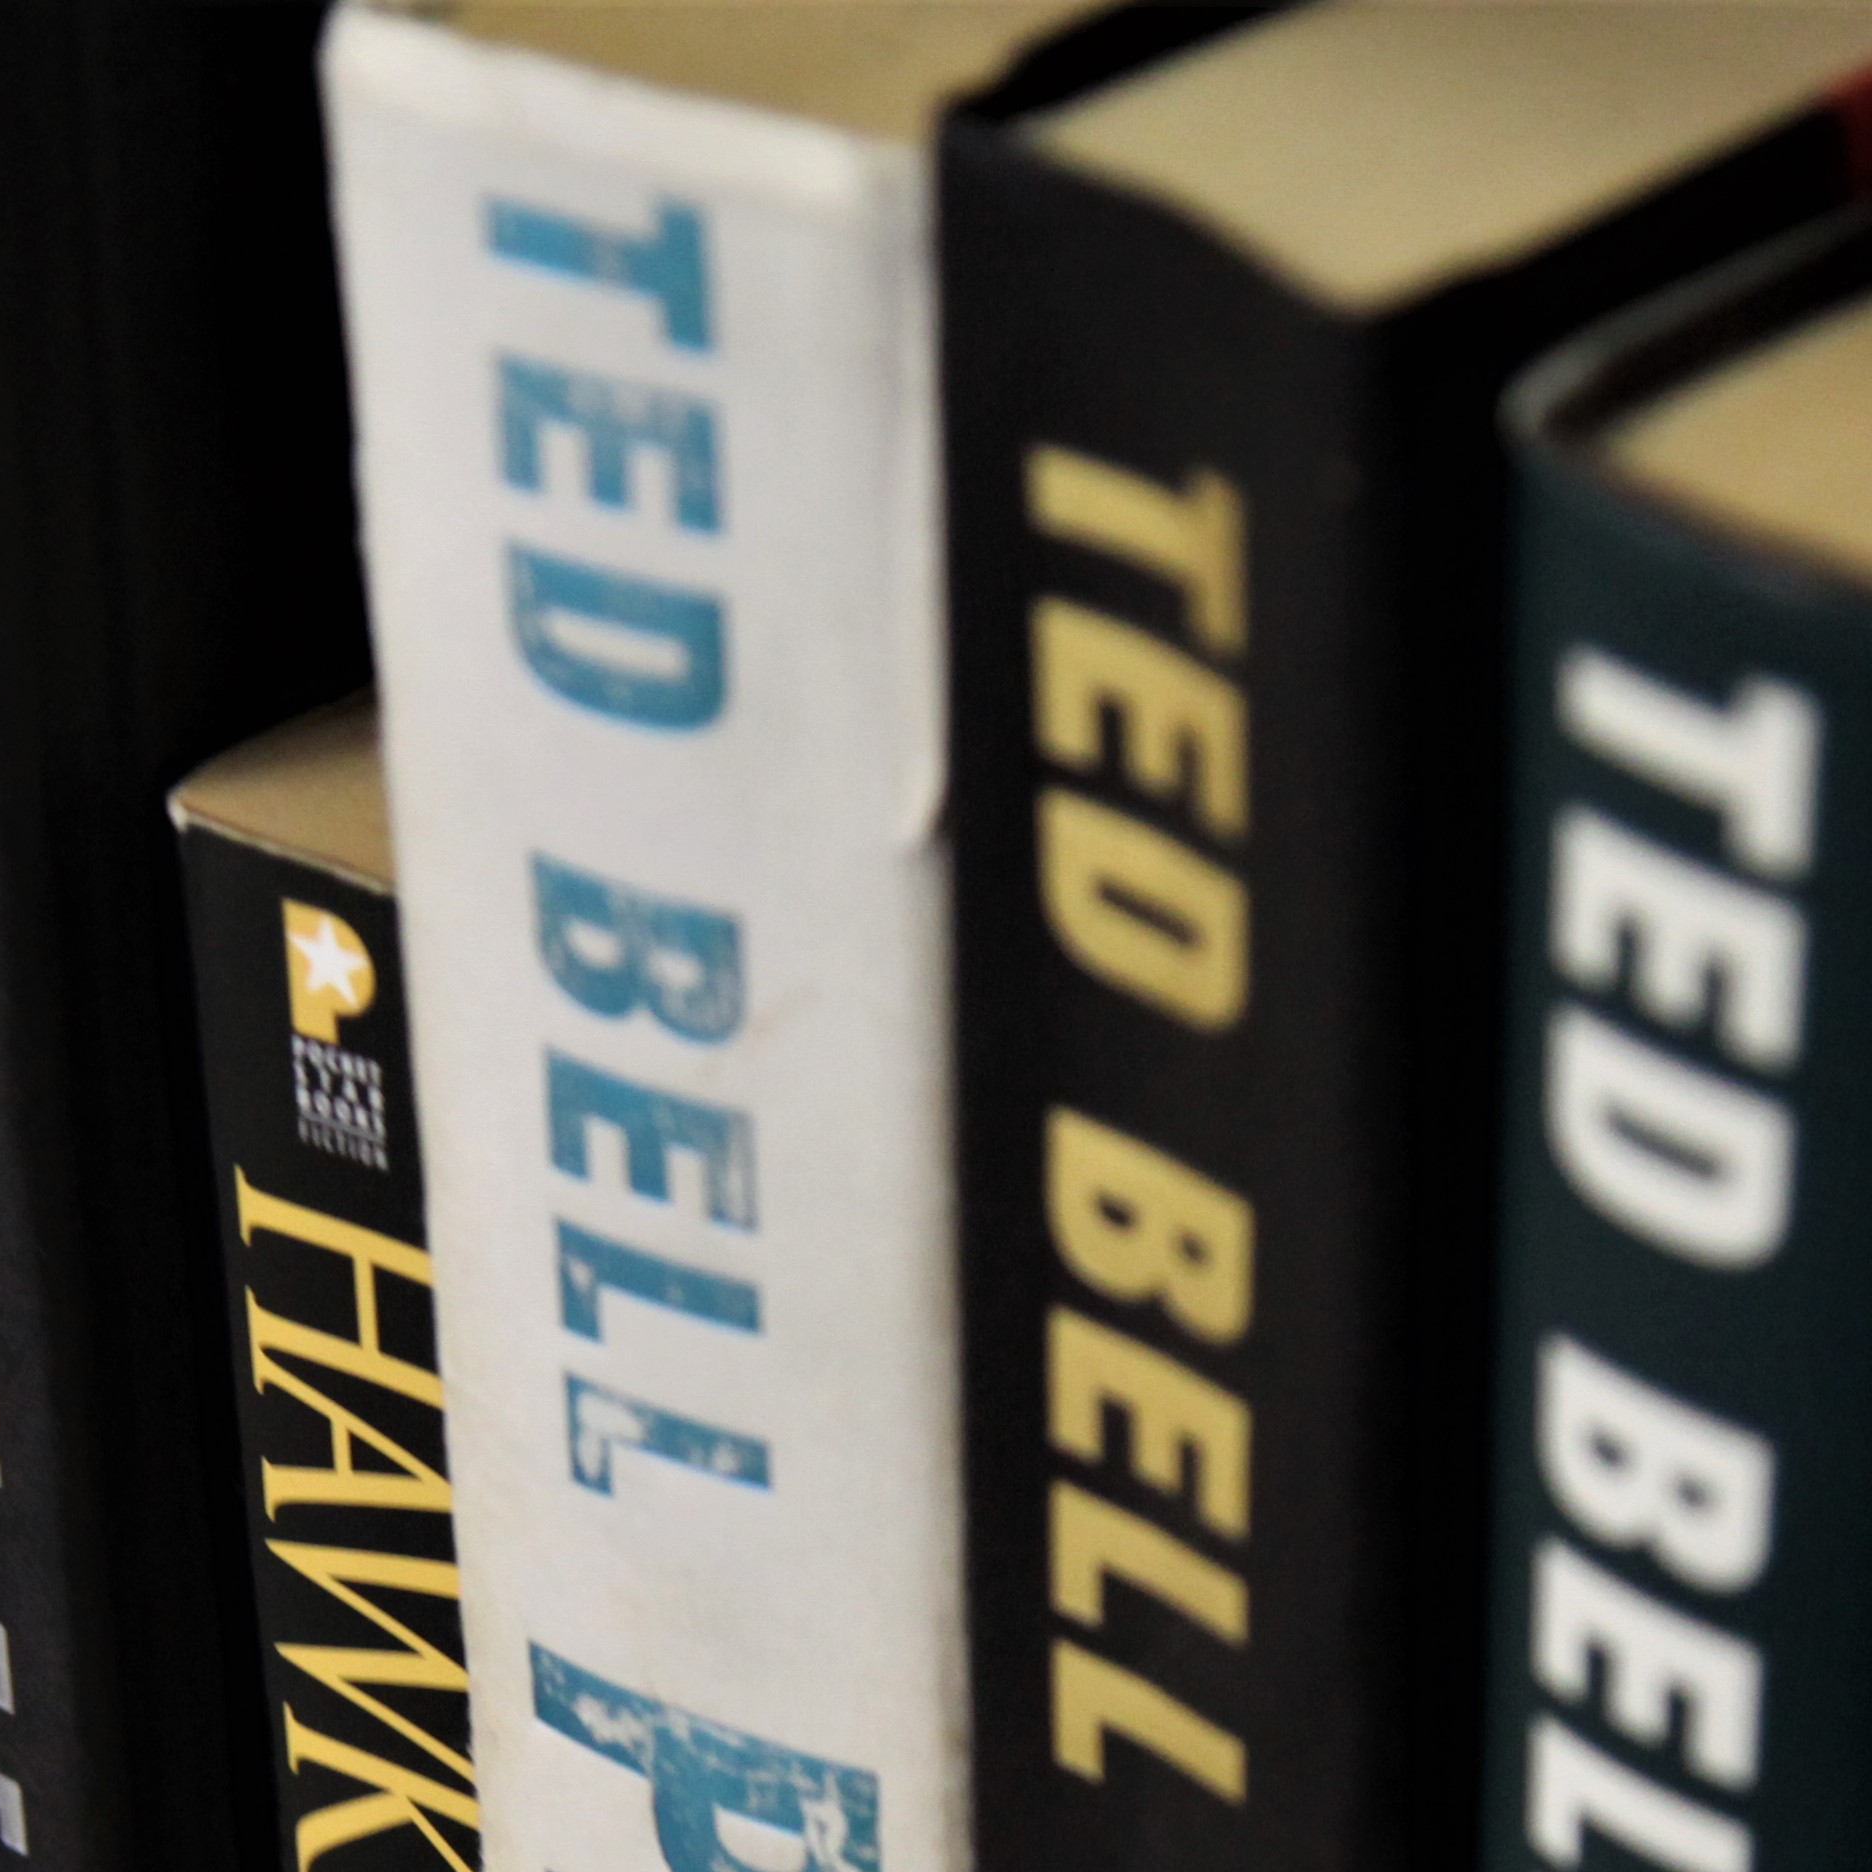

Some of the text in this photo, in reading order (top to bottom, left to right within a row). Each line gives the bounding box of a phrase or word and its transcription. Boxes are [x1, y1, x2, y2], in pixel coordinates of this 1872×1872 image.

[478, 196, 774, 1497] TED BELL
[1028, 442, 1256, 1806] TED BELL
[1545, 643, 1823, 1272] TED
